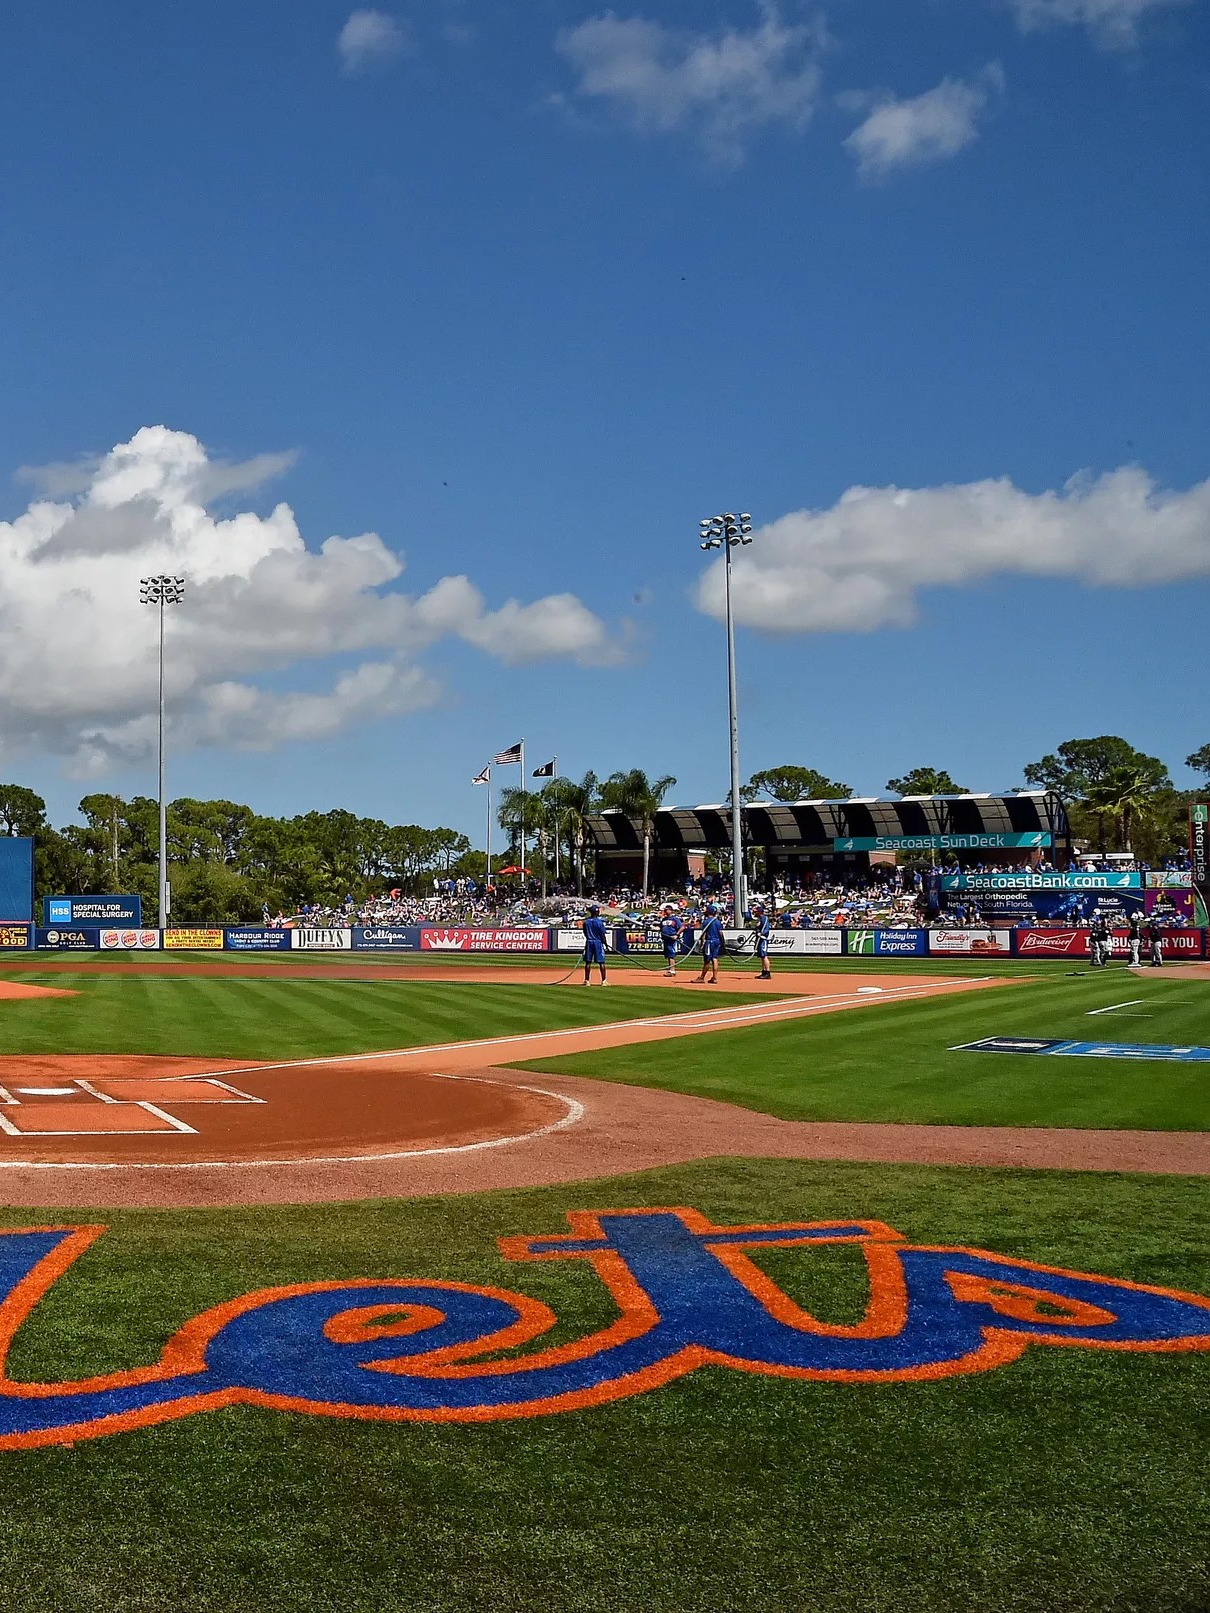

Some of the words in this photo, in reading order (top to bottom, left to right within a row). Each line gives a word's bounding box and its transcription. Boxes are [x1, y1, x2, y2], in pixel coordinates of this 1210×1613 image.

[876, 837, 937, 849] Seacoast
[941, 836, 966, 848] Sun
[970, 834, 1004, 847] Deck
[1194, 808, 1206, 881] enterprise
[966, 874, 1107, 889] SeacoastBank.com
[363, 929, 406, 943] Culligan
[470, 932, 492, 940] TIRE
[496, 932, 543, 940] KINGDOM
[880, 932, 905, 940] Holiday
[1026, 936, 1070, 946] Budweiser
[880, 942, 916, 952] Express
[1172, 937, 1198, 948] YOU.
